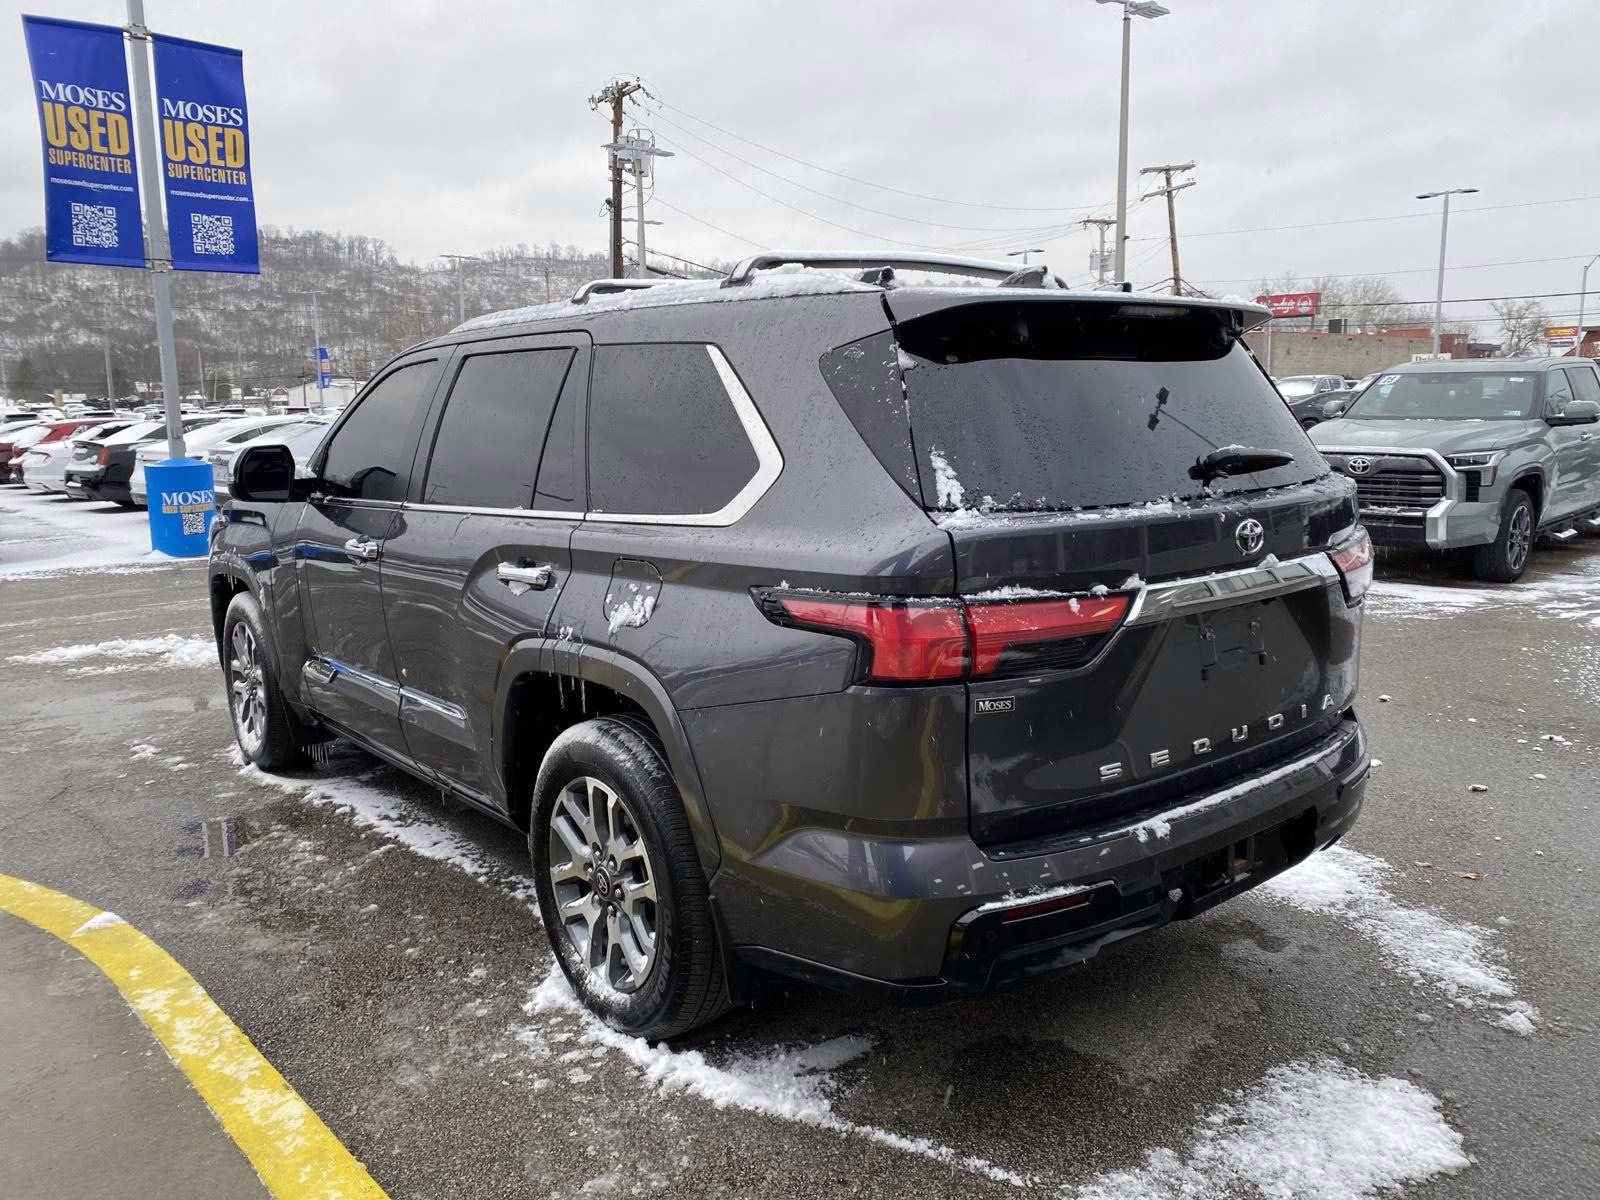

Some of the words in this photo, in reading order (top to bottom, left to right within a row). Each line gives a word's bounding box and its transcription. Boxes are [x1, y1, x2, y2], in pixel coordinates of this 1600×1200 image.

[38, 79, 126, 112] MOSES
[162, 97, 244, 127] MOSES
[42, 101, 130, 156] USED
[163, 119, 245, 168] USED
[48, 147, 132, 174] SUPERCENTER
[167, 162, 247, 186] SUPERCENTER
[50, 177, 134, 193] mosesusedsupercenter.com
[170, 189, 249, 203] mosesusedsupercenter.com
[160, 490, 214, 506] MOSES
[978, 700, 1012, 712] MOSES
[1099, 693, 1335, 782] SEQUOIA
